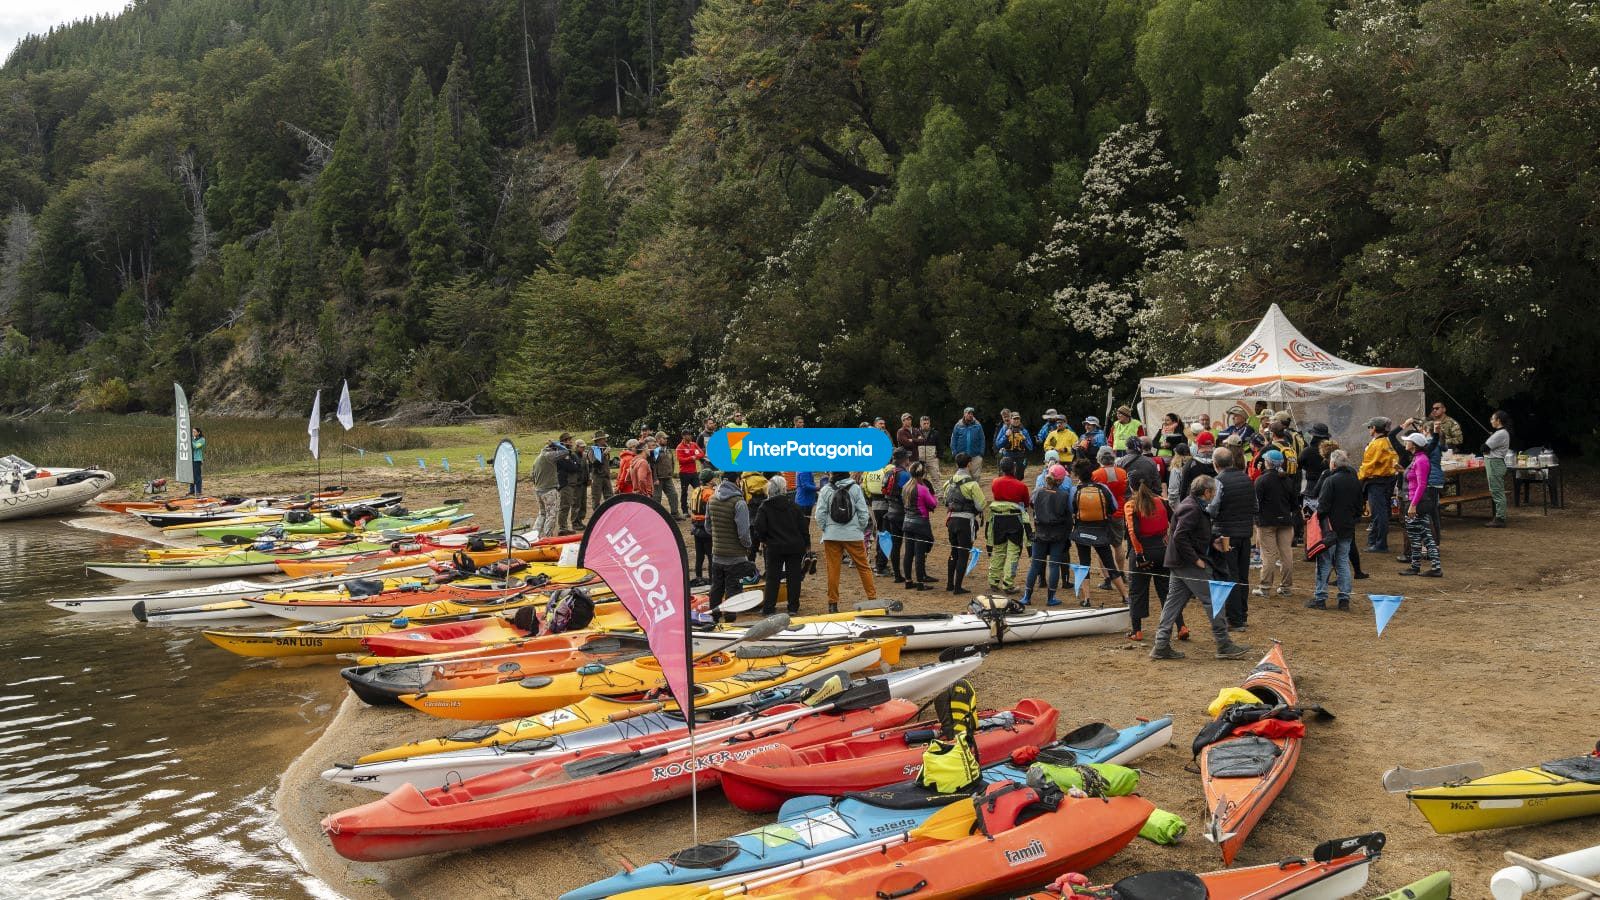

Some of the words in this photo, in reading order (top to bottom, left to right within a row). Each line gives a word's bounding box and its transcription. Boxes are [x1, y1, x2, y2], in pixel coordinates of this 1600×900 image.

[276, 637, 297, 647] SAN
[299, 638, 323, 648] LUIS
[651, 750, 731, 781] ROCKER
[868, 818, 916, 835] toledo
[1004, 838, 1046, 864] famili
